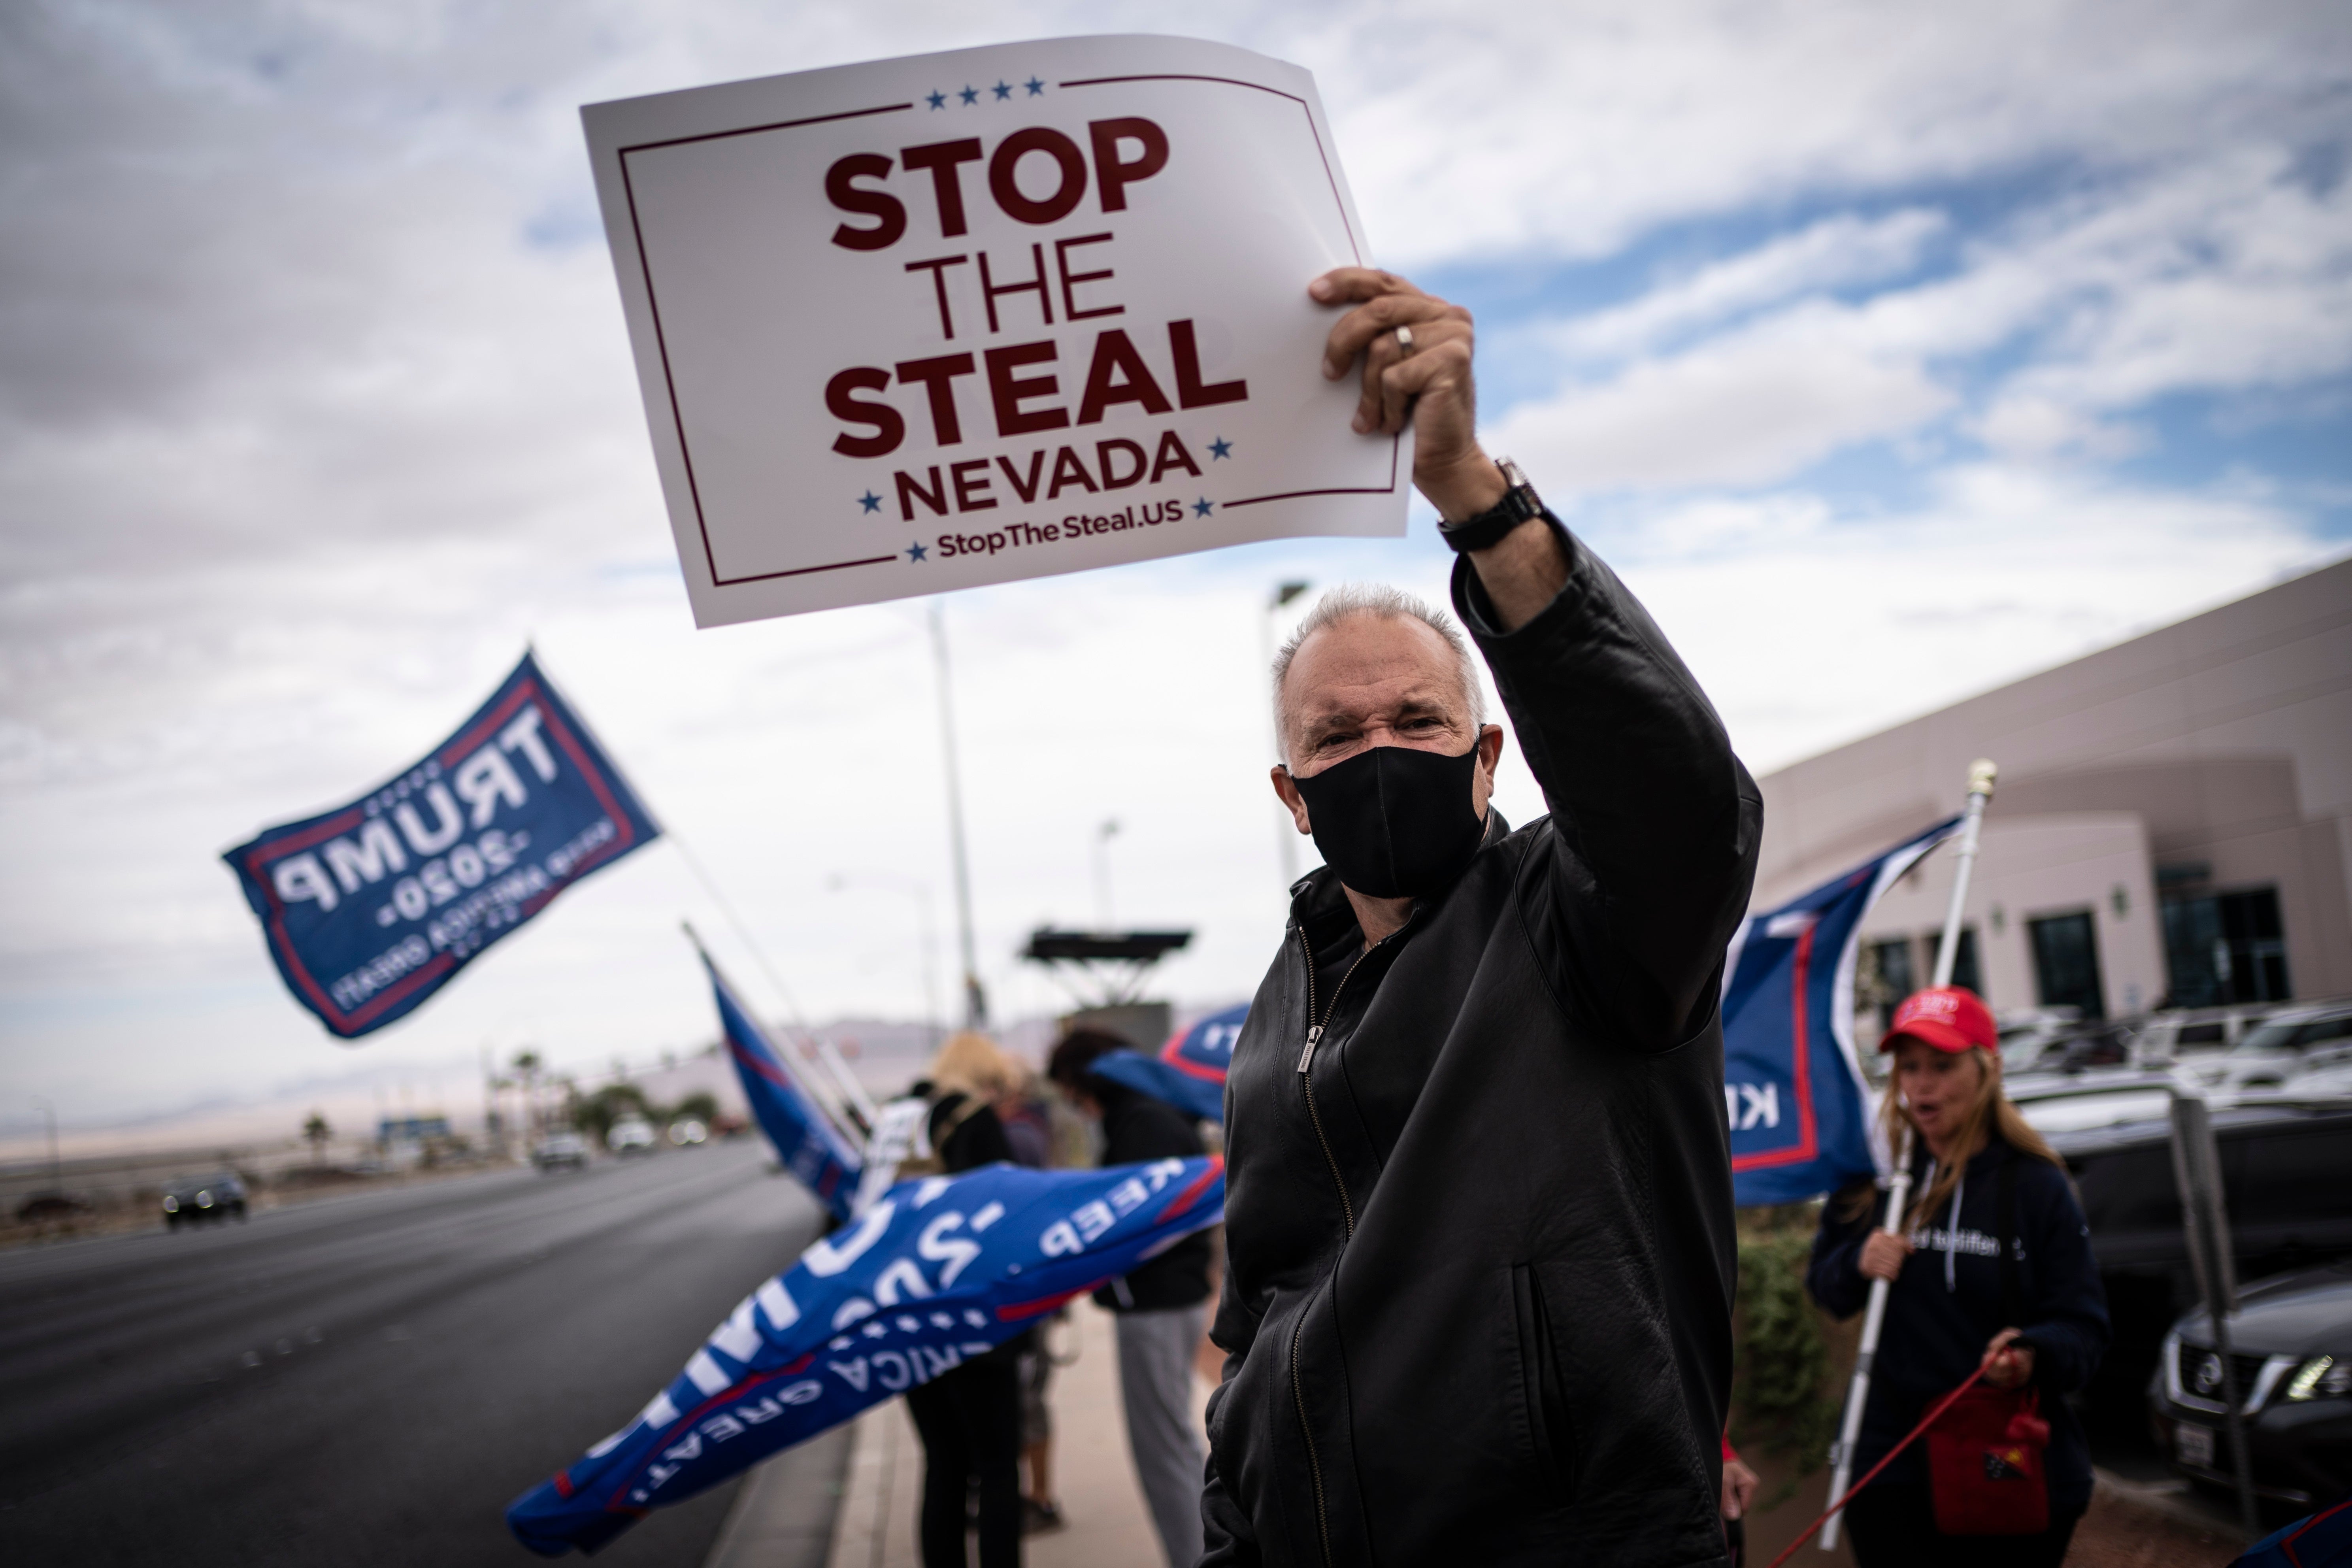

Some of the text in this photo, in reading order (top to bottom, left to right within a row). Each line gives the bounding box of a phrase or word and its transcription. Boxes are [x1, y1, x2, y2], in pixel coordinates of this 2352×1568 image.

[824, 116, 1169, 252] STOP
[905, 231, 1125, 340] THE
[824, 319, 1249, 459] STEAL
[893, 430, 1203, 521] NEVADA
